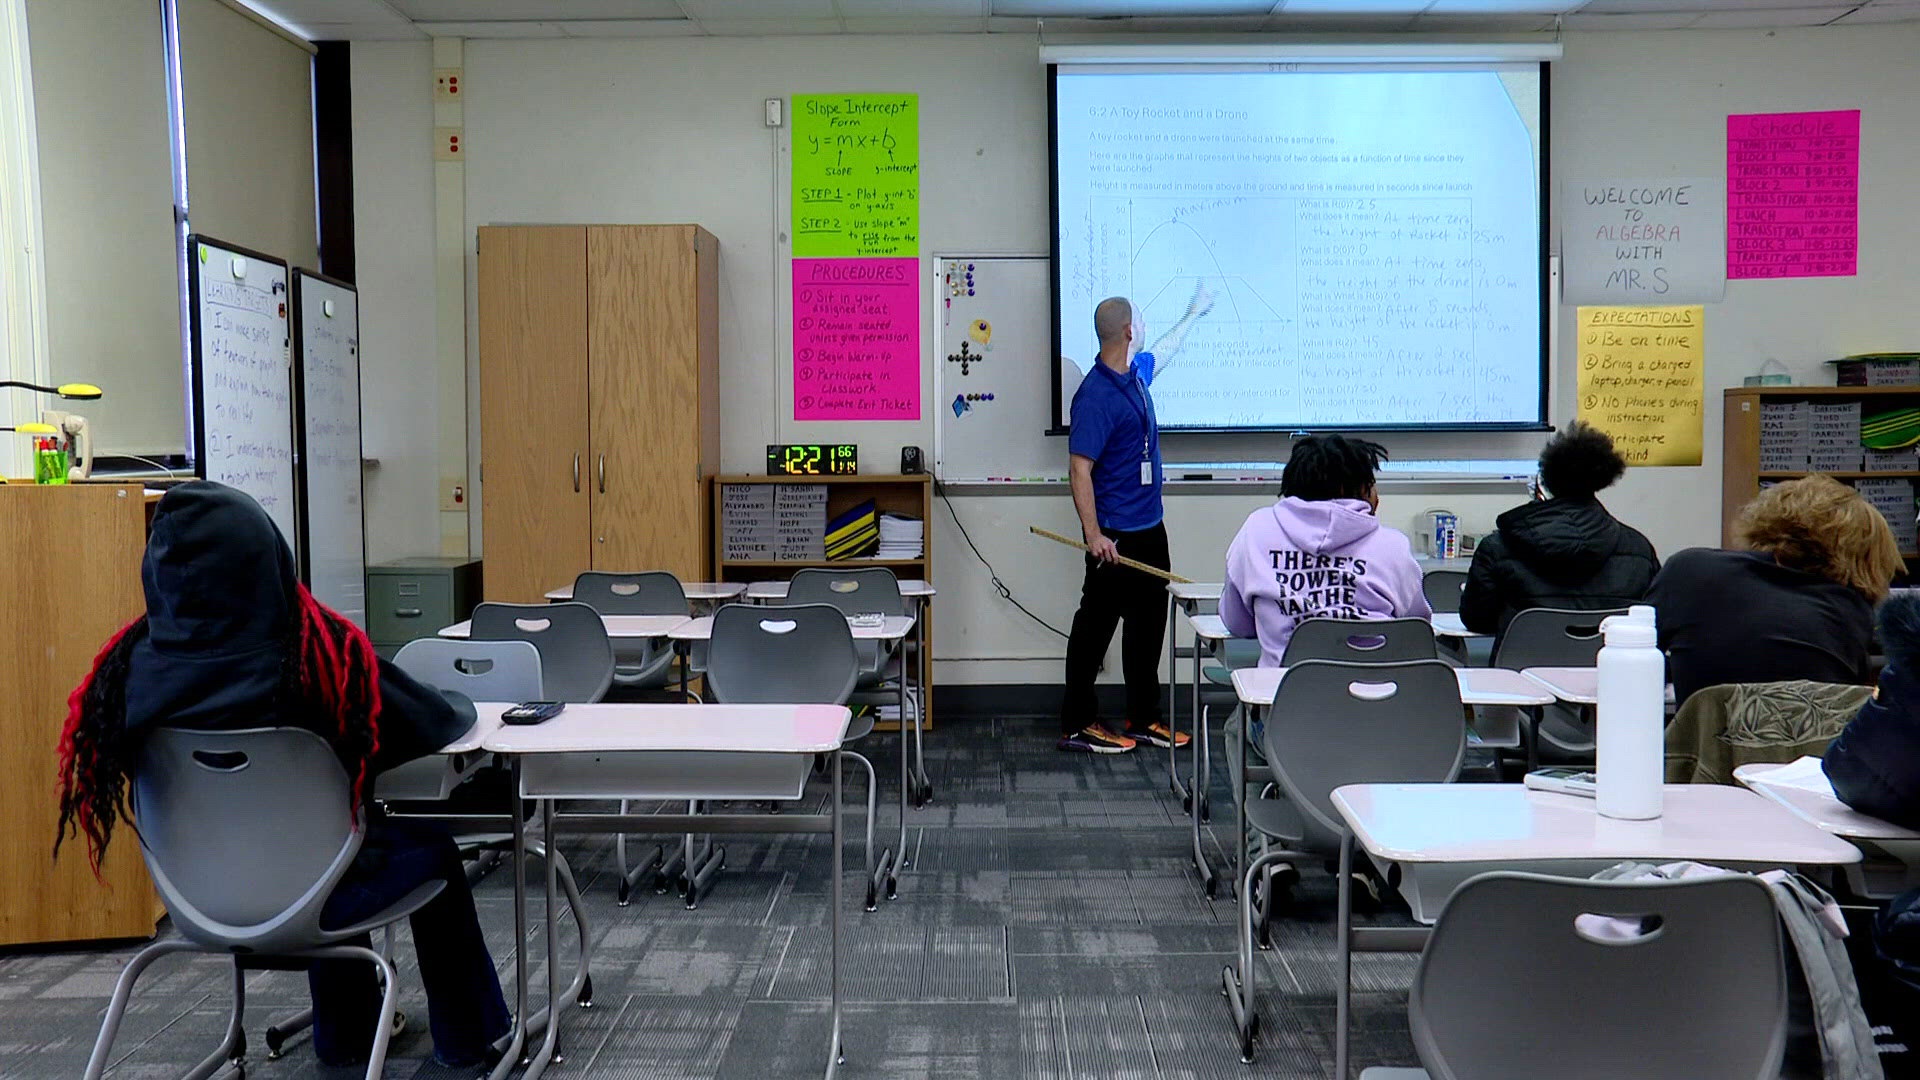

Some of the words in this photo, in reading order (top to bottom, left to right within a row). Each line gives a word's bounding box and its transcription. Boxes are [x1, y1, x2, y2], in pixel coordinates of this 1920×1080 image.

[806, 101, 841, 117] Slope
[844, 99, 908, 117] Intercept
[1089, 106, 1107, 118] 6.2
[1110, 107, 1118, 117] A
[1121, 107, 1140, 120] Toy
[1142, 107, 1180, 119] Rocket
[1183, 108, 1203, 119] and
[1206, 110, 1213, 119] a
[1215, 108, 1248, 120] Drone
[830, 117, 860, 127] Form
[1750, 117, 1836, 137] Schedule
[1089, 131, 1097, 140] A
[1098, 132, 1111, 143] toy
[1114, 132, 1142, 141] rocket
[1145, 132, 1161, 142] and
[1170, 132, 1197, 142] drone
[1222, 132, 1263, 144] launched
[1275, 134, 1289, 144] the
[1291, 136, 1314, 145] same
[1735, 151, 1766, 162] BLOCK
[825, 167, 852, 176] SLOPE
[875, 164, 917, 175] y-intercept
[1737, 165, 1799, 177] TRANSITION
[1090, 180, 1118, 192] Height
[1130, 181, 1172, 191] measured
[1735, 180, 1770, 191] BLOCK
[1773, 181, 1782, 191] 2
[801, 188, 831, 200] STEP
[834, 188, 843, 200] 1
[857, 188, 877, 200] Plot
[1584, 185, 1693, 206] WELCOME
[1736, 193, 1807, 205] TRANSITION
[850, 202, 861, 210] on
[1300, 200, 1320, 208] What
[1300, 211, 1320, 220] What
[1323, 211, 1341, 220] does
[1624, 208, 1644, 223] TO
[1735, 210, 1776, 222] LUNCH
[801, 218, 830, 229] STEP
[834, 218, 841, 229] 2
[872, 219, 895, 230] slope
[1736, 223, 1804, 238] TRANSITION
[849, 231, 858, 239] to
[884, 233, 900, 242] from
[904, 231, 916, 241] the
[1596, 224, 1681, 243] ALGEBRA
[856, 246, 898, 255] y-intercept
[1736, 239, 1774, 250] BLOCK
[1778, 240, 1786, 250] 3
[1615, 246, 1663, 261] WITH
[1736, 252, 1801, 262] TRANSITION
[811, 263, 905, 281] PROCEDURES
[1734, 266, 1774, 276] BLOCK
[1777, 266, 1788, 276] 4
[1605, 268, 1647, 291] MR.
[1652, 267, 1669, 295] S
[816, 289, 834, 303] Sit
[840, 293, 850, 303] in
[855, 294, 881, 307] your
[813, 304, 856, 318] assigned
[863, 303, 888, 315] seat
[1592, 310, 1692, 324] EXPECTATIONS
[818, 318, 853, 331] Remain
[859, 320, 892, 330] seated
[841, 333, 861, 346] given
[863, 333, 910, 345] permission
[1602, 332, 1623, 347] Be
[1630, 336, 1648, 347] on
[1656, 335, 1690, 348] time
[817, 352, 844, 365] Begin
[1602, 354, 1632, 375] Bring
[1638, 362, 1645, 370] a
[1650, 360, 1691, 375] charged
[817, 368, 873, 383] Participate
[880, 372, 891, 380] in
[1665, 376, 1695, 388] pencil
[818, 398, 854, 411] Complete
[857, 398, 876, 410] Exit
[880, 399, 913, 410] Ticket
[1669, 397, 1699, 416] during
[1607, 413, 1665, 423] instruction
[786, 446, 835, 474] 12:21
[1625, 449, 1649, 461] kind
[1269, 550, 1367, 575] THERE'S
[1276, 570, 1357, 591] POWER
[1308, 588, 1356, 607] THE
